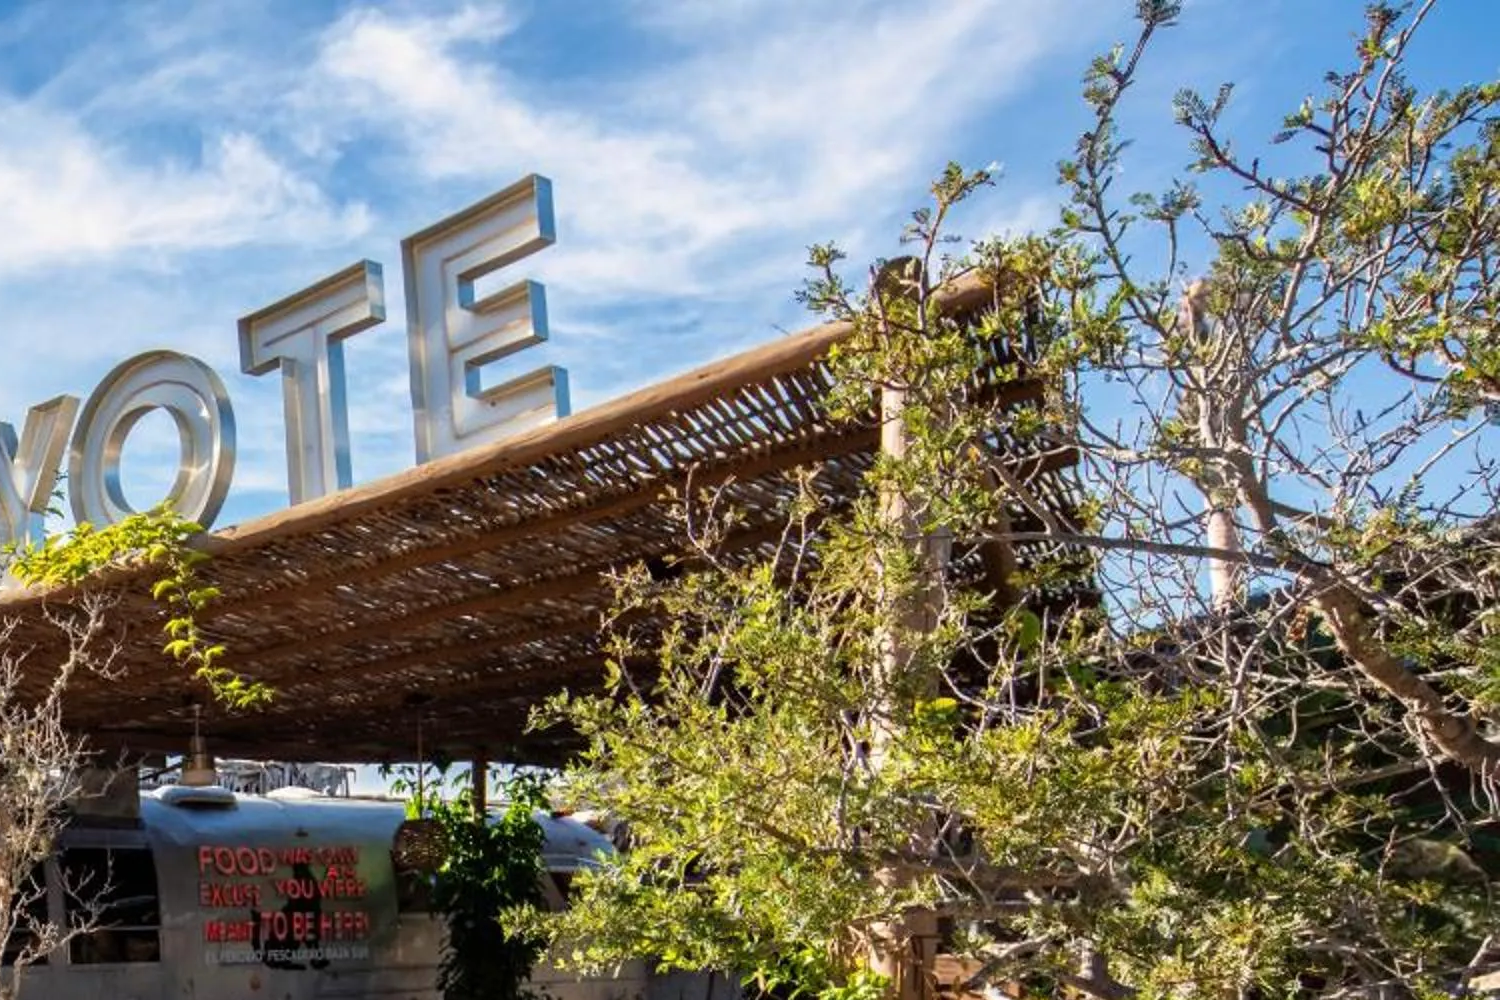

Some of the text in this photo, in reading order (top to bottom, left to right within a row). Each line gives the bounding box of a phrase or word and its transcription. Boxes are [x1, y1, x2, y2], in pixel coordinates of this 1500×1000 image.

[198, 845, 277, 875] FOOD
[200, 879, 367, 906] EXCUSE YOU WERE
[260, 911, 288, 941] TO
[293, 911, 316, 941] BE
